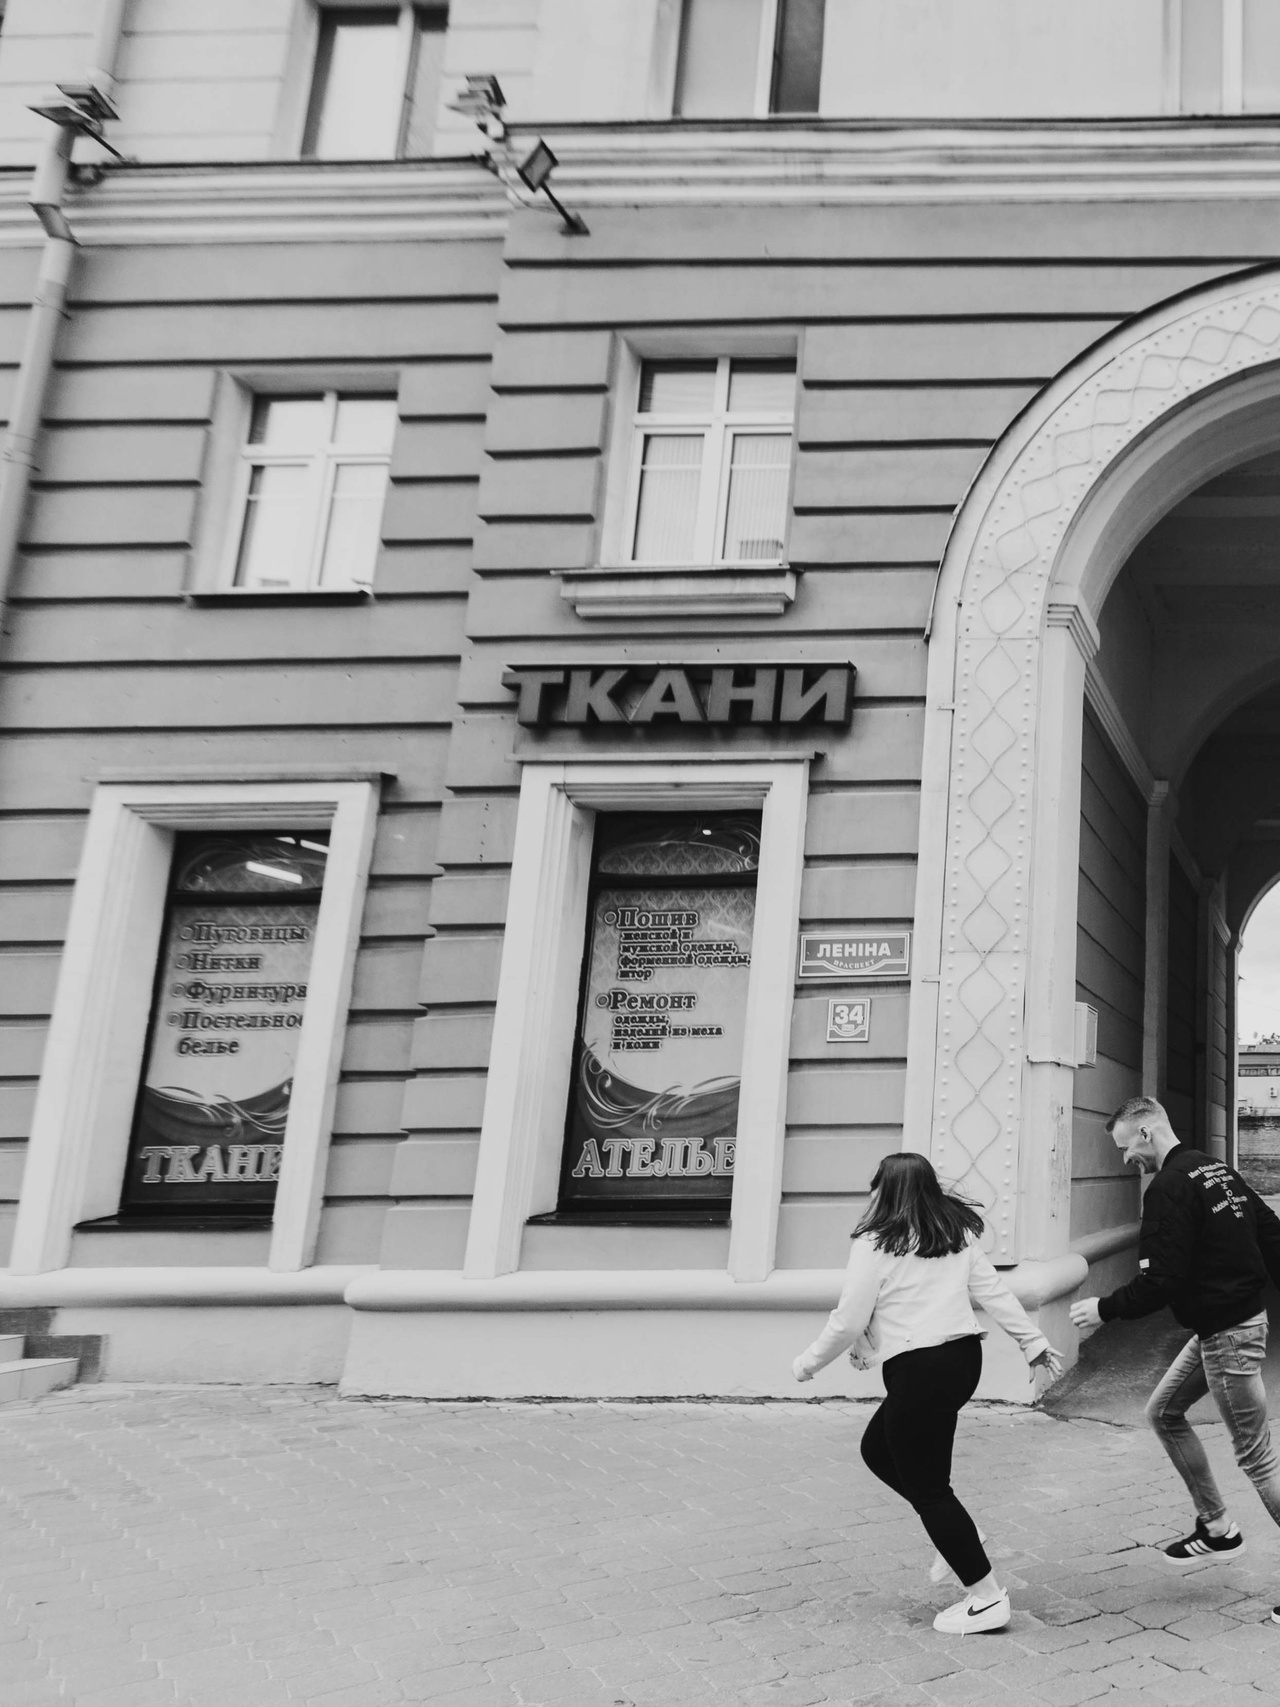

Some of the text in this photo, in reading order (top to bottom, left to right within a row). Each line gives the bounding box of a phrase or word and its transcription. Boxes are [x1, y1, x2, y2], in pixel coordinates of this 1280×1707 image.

[501, 667, 850, 724] ТКАНИ
[617, 908, 698, 928] Пошив
[193, 922, 308, 947] Пуговицы
[621, 929, 692, 941] женской и
[621, 941, 680, 954] мужской
[817, 942, 892, 958] ЛЕНІНА
[188, 951, 261, 971] Нитки
[620, 953, 695, 968] форменной
[833, 959, 875, 969] ПРАСПЕКТ
[618, 969, 653, 981] штор
[609, 990, 697, 1011] Ремонт
[614, 1014, 670, 1026] одежды,
[834, 1005, 864, 1024] 34
[613, 1026, 723, 1038] изделий из меха
[178, 1036, 239, 1056] белье
[612, 1040, 661, 1051] и кожи
[572, 1138, 736, 1177] АТЕЛЬЕ
